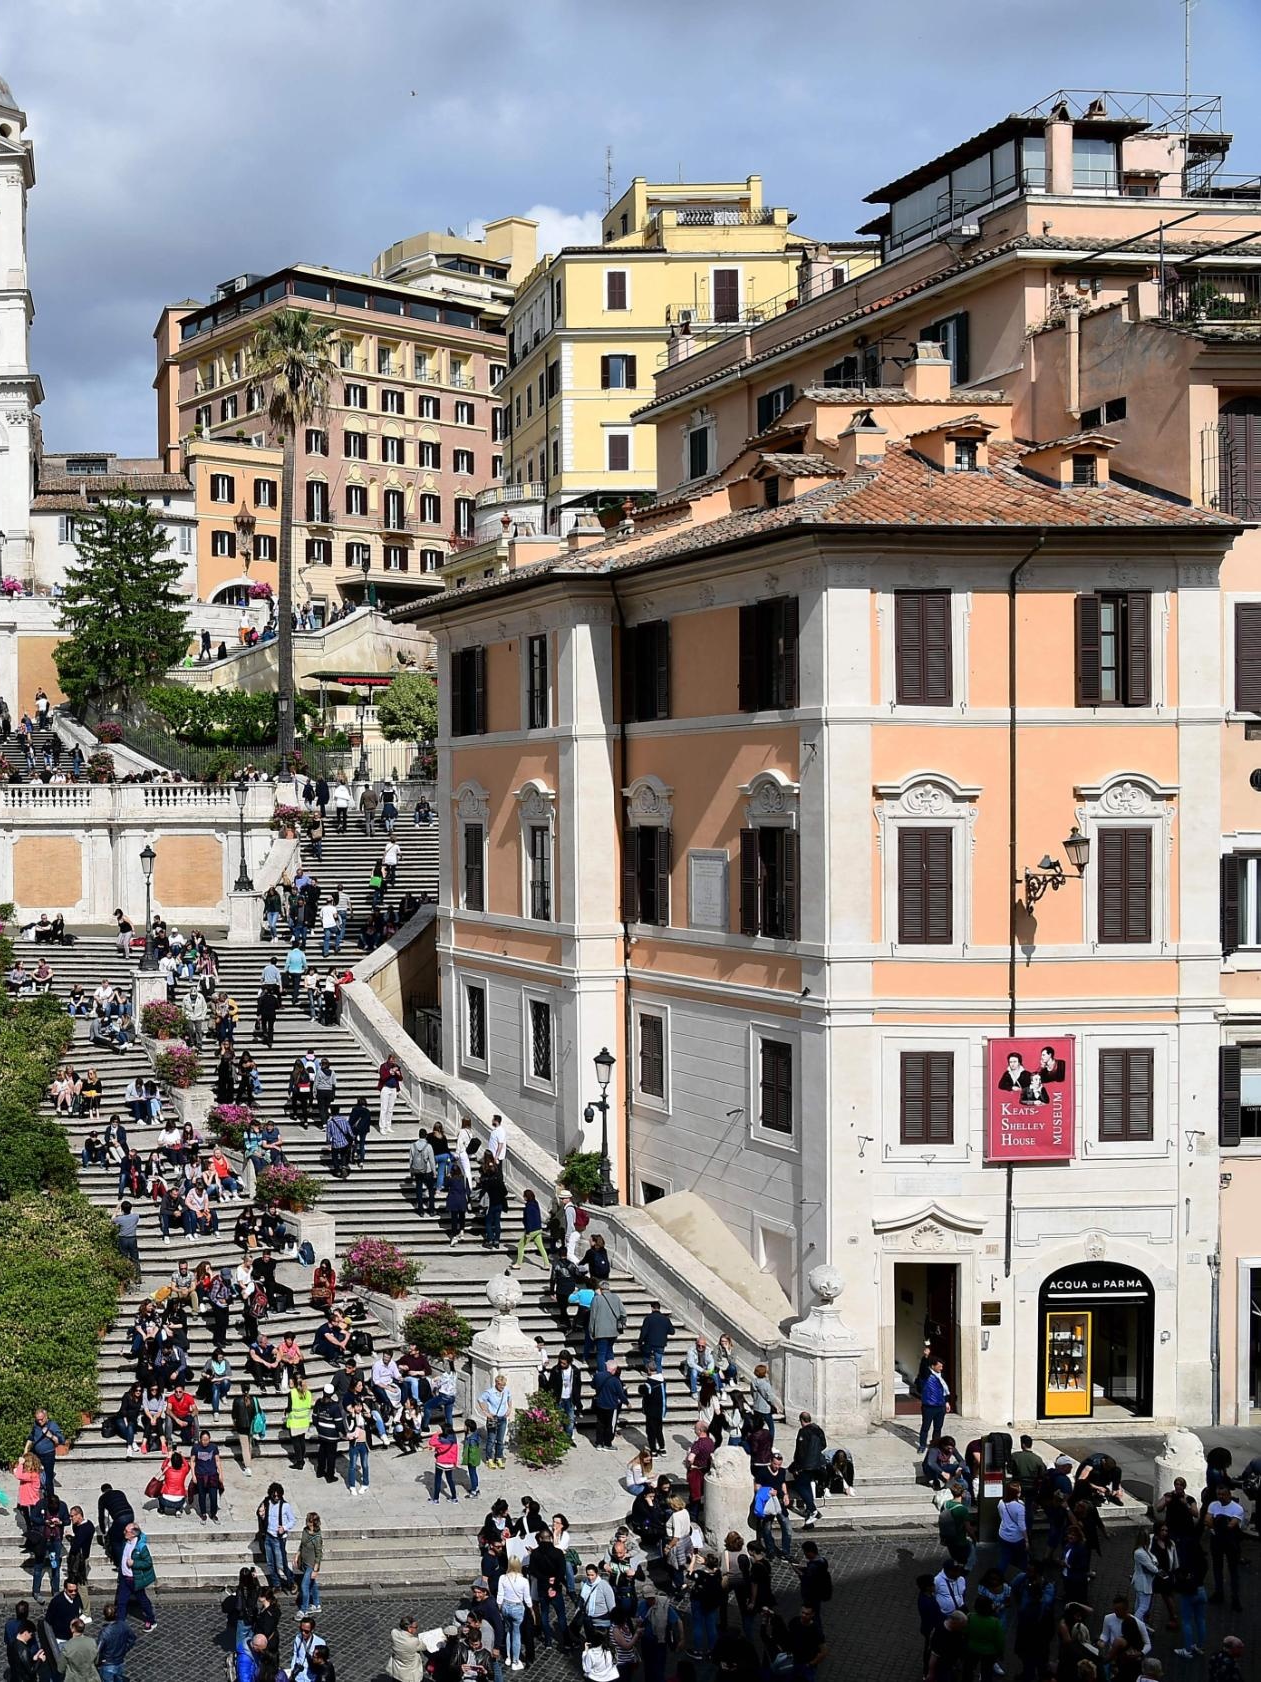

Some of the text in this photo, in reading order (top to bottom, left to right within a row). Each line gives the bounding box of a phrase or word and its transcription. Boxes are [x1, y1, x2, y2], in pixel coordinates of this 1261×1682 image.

[1001, 1118, 1045, 1131] SHELLEY
[1053, 1092, 1063, 1145] MUSEUM
[1001, 1133, 1036, 1146] HOUSE
[1049, 1280, 1088, 1290] ACQUA
[1103, 1279, 1143, 1288] PARMA
